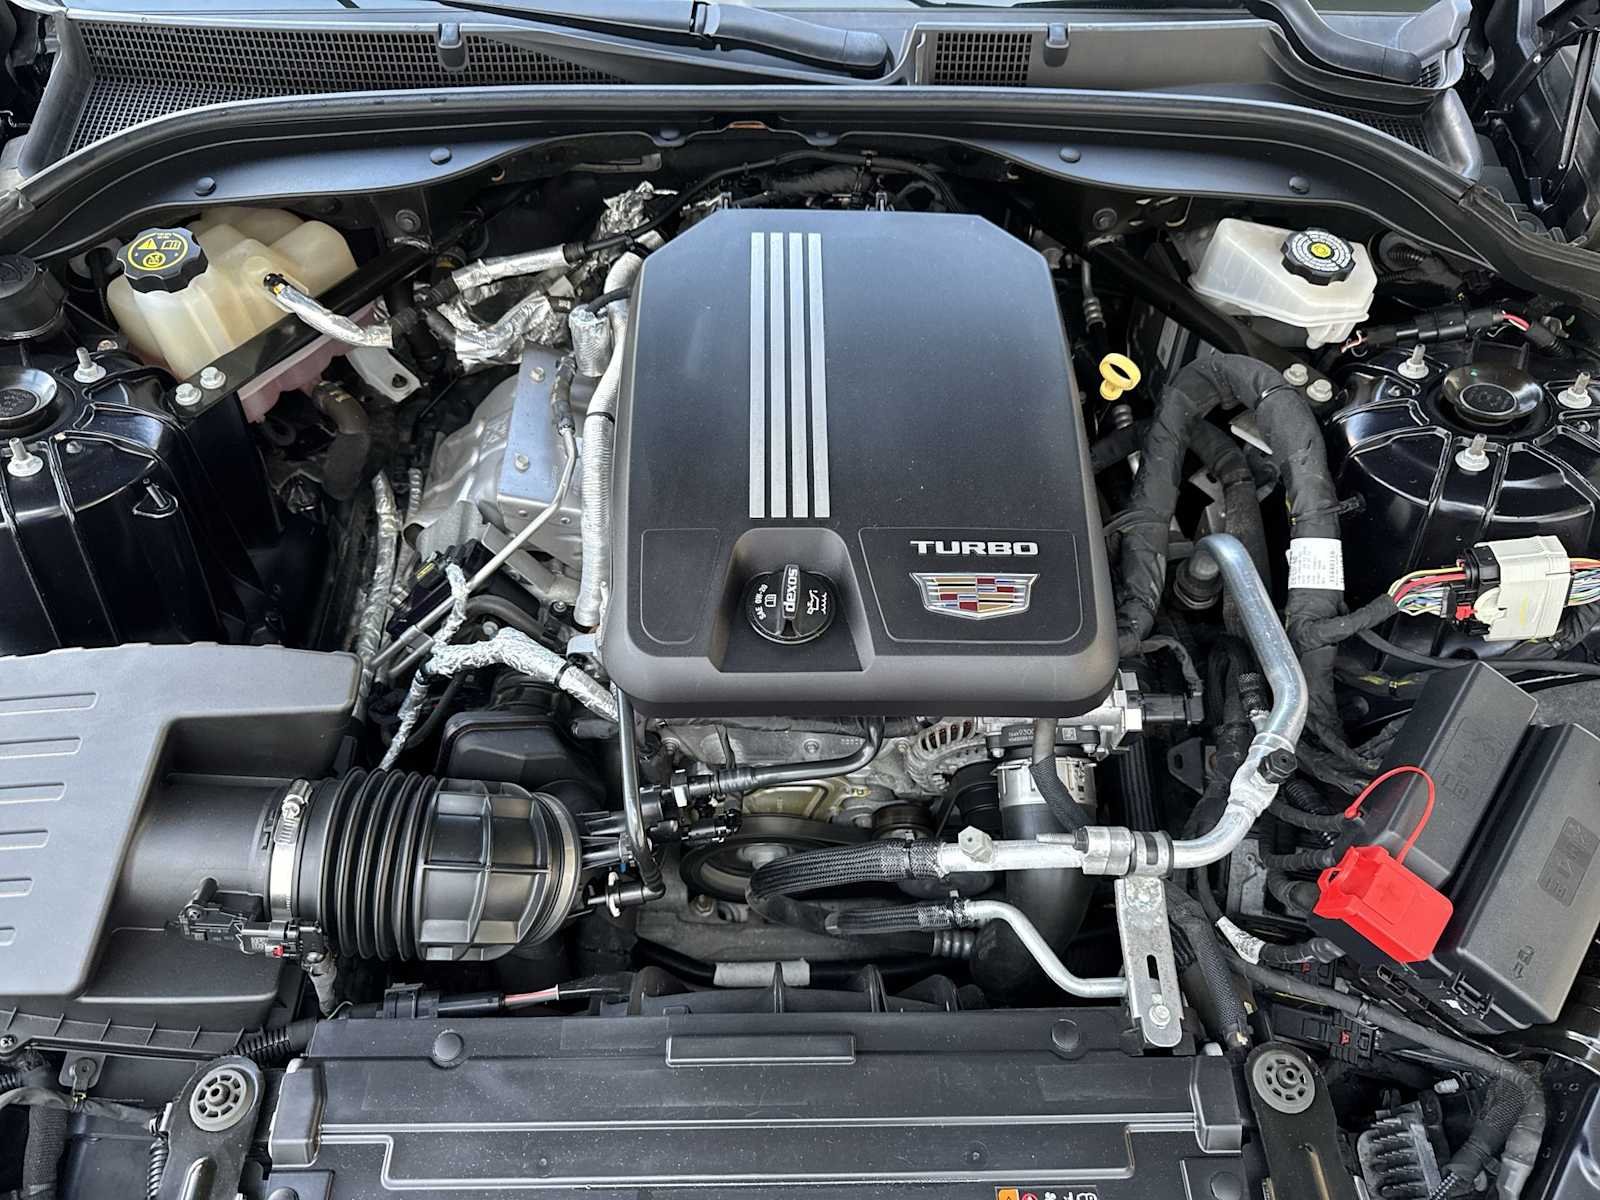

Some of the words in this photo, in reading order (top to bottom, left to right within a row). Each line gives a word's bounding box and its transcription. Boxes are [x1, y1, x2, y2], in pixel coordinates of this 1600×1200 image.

[910, 540, 1039, 555] TURBO
[783, 567, 798, 612] dexos
[755, 606, 766, 620] SAE
